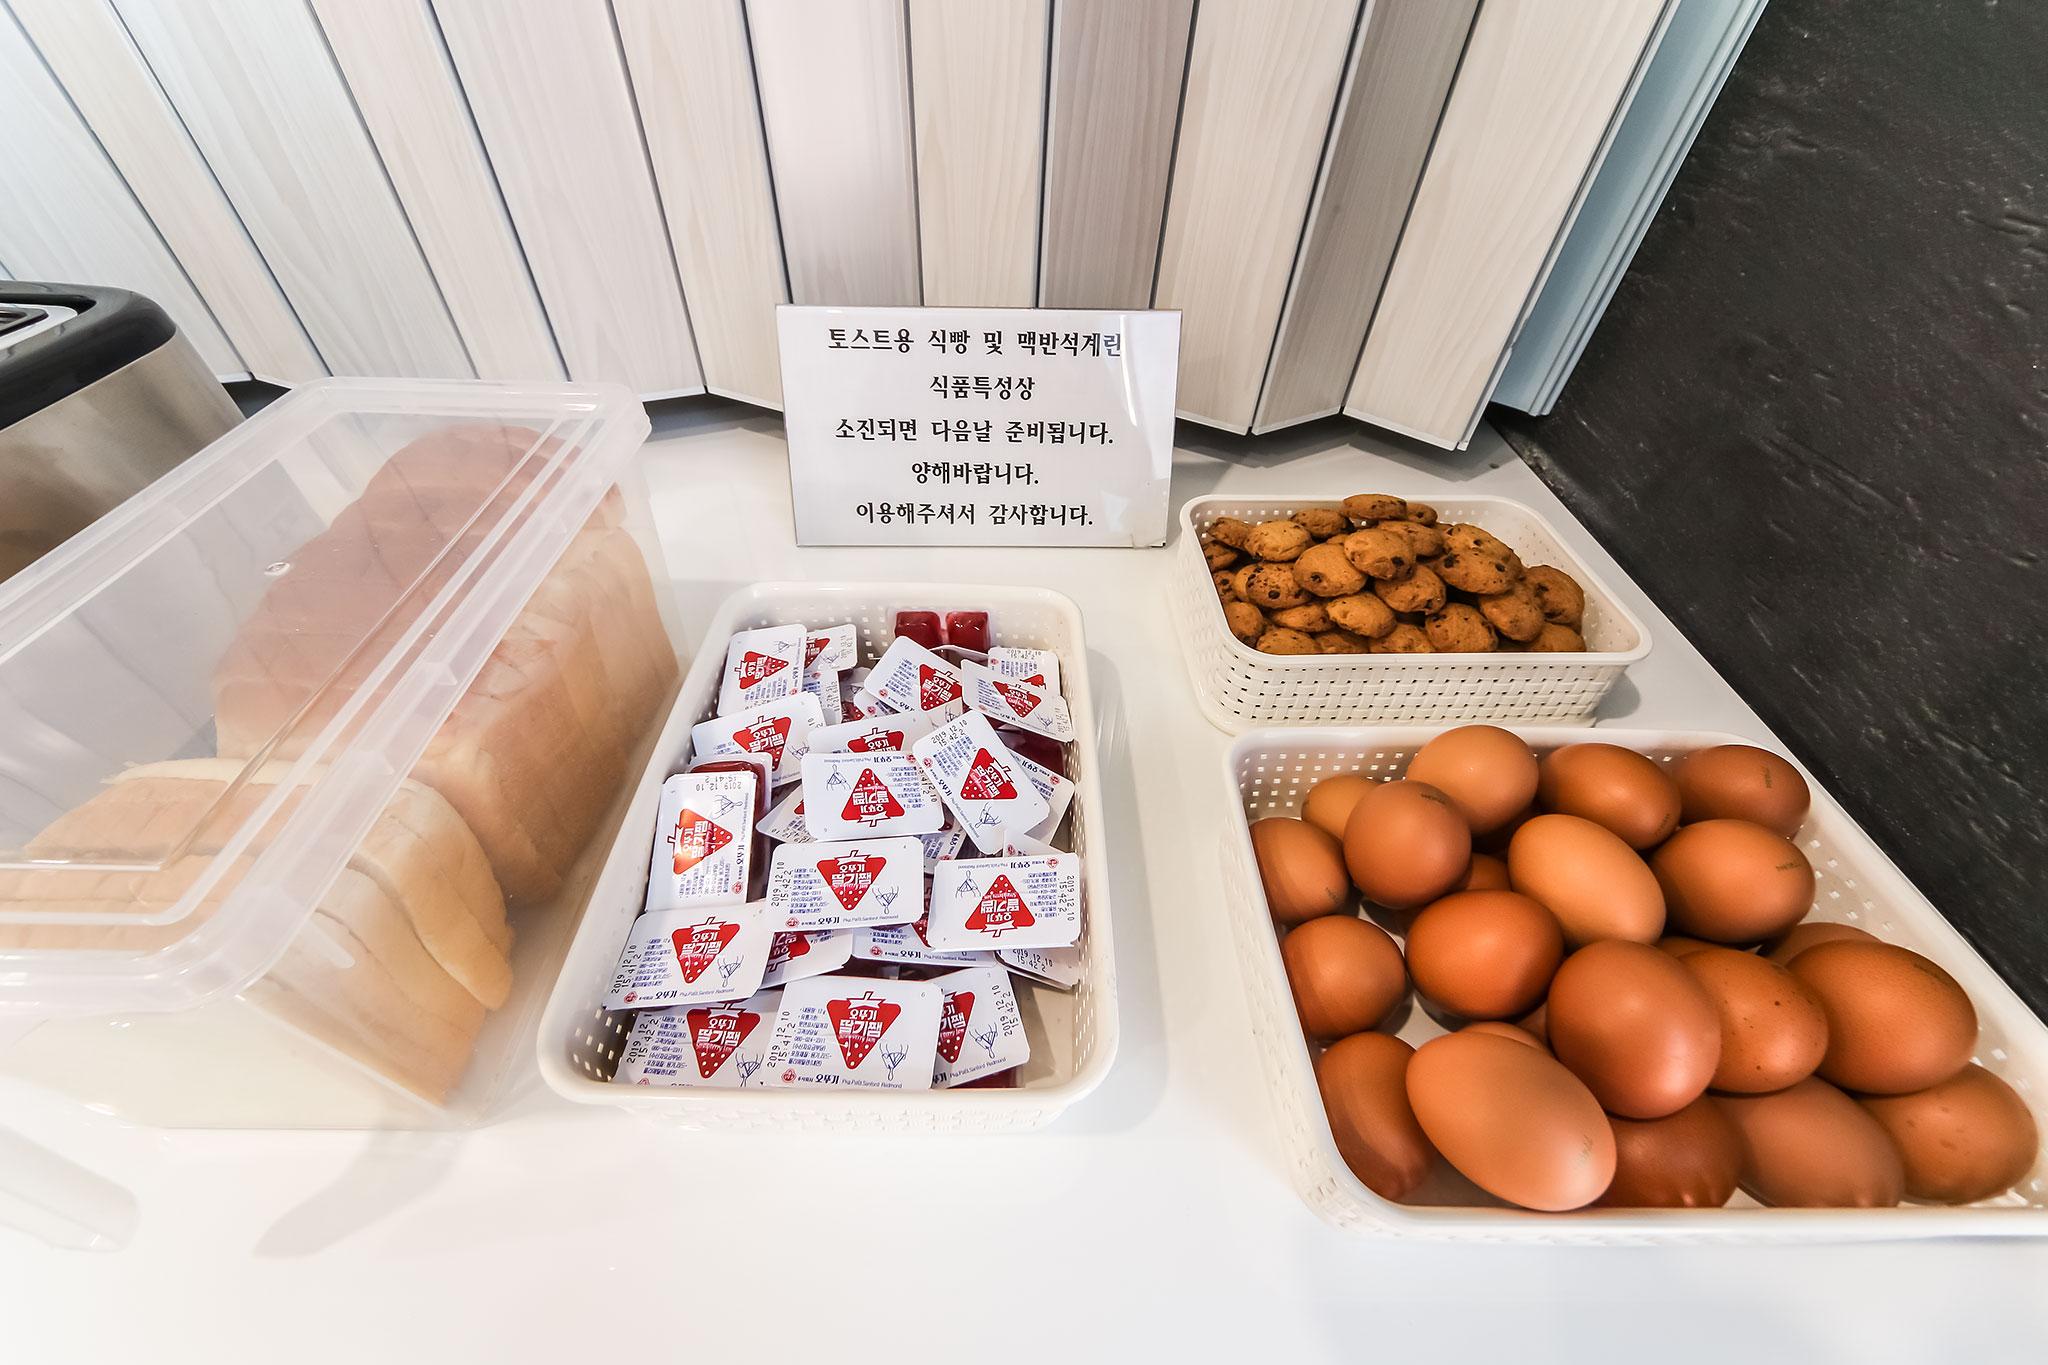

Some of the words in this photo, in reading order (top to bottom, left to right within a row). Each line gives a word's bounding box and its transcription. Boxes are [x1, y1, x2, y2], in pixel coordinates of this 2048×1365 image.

[828, 328, 915, 354] 토스트용
[928, 329, 971, 355] 식빵
[983, 330, 1003, 356] 및
[929, 375, 1036, 401] 식품특성상
[835, 418, 917, 442] 소진되면
[931, 419, 993, 443] 다음날
[1004, 420, 1113, 445] 준비됩니다.
[911, 461, 1039, 486] 양해바랍니다.
[856, 502, 975, 525] 이용해주셔서
[988, 503, 1093, 527] 감사합니다.
[752, 727, 776, 741] 오뚜기
[867, 738, 890, 749] 오뚜기
[839, 863, 865, 873] 오뚜기
[1010, 861, 1031, 869] 오뚜기
[817, 916, 840, 925] 오뚜기
[986, 911, 1012, 922] 오뚜기
[692, 931, 718, 942] 오뚜기
[900, 950, 921, 959] 오뚜기
[655, 990, 678, 1000] 오뚜기
[849, 1009, 877, 1021] 오뚜기
[940, 1012, 967, 1030] 기쨈
[708, 1018, 737, 1031] 오뚜기
[626, 1013, 653, 1063] 2019.12.1
[815, 1073, 840, 1085] 오뚜기
[933, 1071, 947, 1085] 뚜기
